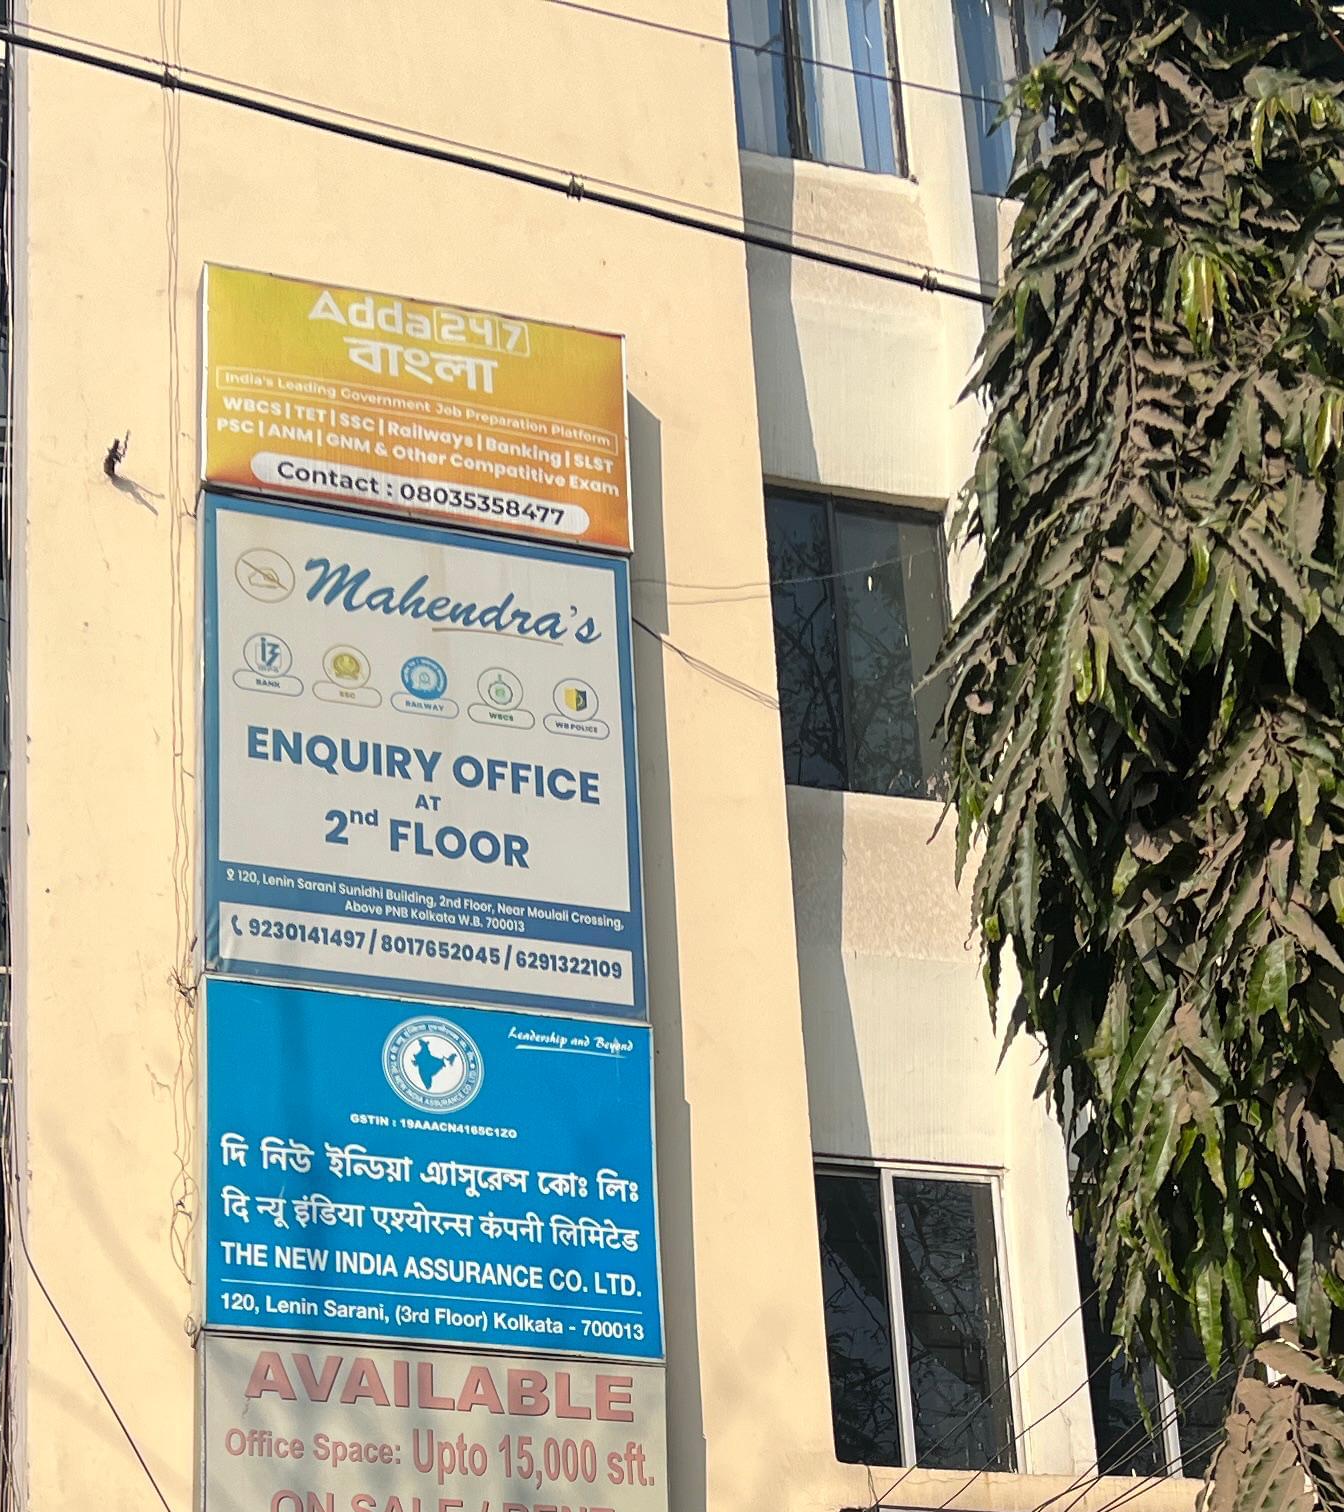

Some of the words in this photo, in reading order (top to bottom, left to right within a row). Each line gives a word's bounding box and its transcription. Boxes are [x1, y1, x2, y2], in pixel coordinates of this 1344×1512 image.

[343, 336, 497, 394] বাংলা
[223, 396, 282, 416] WBCS
[294, 405, 326, 422] TET
[339, 411, 375, 432] SSC
[388, 421, 473, 449] Railways
[486, 437, 561, 468] Banking
[574, 453, 614, 474] SLST
[225, 372, 272, 388] India's
[277, 378, 337, 399] Leading
[341, 386, 431, 413] Government
[437, 402, 462, 417] Job
[466, 407, 548, 434] Preparation
[551, 424, 611, 447] Platform
[217, 418, 253, 435] PSC
[267, 424, 312, 445] ANM
[326, 432, 370, 455] GNM
[391, 445, 447, 470] Other
[569, 474, 619, 497] Exam
[277, 461, 379, 495] Contact
[400, 483, 565, 527] 08035358477
[304, 557, 602, 645] Mahendra's
[247, 726, 442, 784] ENQUIRY
[453, 754, 600, 805] OFFICE
[415, 794, 441, 811] AT
[324, 807, 378, 845] 2nd
[389, 817, 530, 869] FLOOR
[238, 870, 260, 887] 120,
[262, 873, 294, 889] Lenin
[297, 877, 336, 896] Sarani
[339, 881, 383, 901] Sunidhi
[386, 887, 435, 909] Building,
[439, 895, 461, 909] 2nd
[463, 897, 494, 913] Floor,
[497, 902, 524, 917] Near
[527, 906, 569, 923] Moulali
[572, 910, 624, 933] Crossing,
[345, 900, 382, 915] Above
[385, 904, 407, 918] PNB
[410, 906, 455, 924] Kolkata
[457, 913, 483, 927] W.B.
[486, 915, 525, 933] 700013
[249, 918, 365, 950] 9230141497
[380, 934, 500, 965] 8017652045
[515, 949, 622, 979] 6291322109
[508, 1025, 566, 1048] Leadership
[570, 1035, 590, 1048] and
[595, 1037, 634, 1054] Beyond
[350, 1113, 388, 1127] GSTIN
[221, 1133, 248, 1167] দি
[259, 1136, 314, 1173] নিউ
[221, 1186, 249, 1222] दि
[256, 1196, 289, 1230] न्यू
[294, 1193, 365, 1229] इंडिया
[480, 1209, 543, 1245] कंपनी
[551, 1214, 638, 1252] लिमिटेड
[221, 1242, 267, 1267] THE
[275, 1246, 328, 1271] NEW
[335, 1251, 398, 1277] INDIA
[404, 1257, 543, 1290] ASSURANCE
[549, 1267, 589, 1292] CO.
[594, 1270, 642, 1297] LTD.
[221, 1292, 259, 1316] 120,
[266, 1295, 318, 1316] Lenin
[324, 1300, 390, 1324] Sarani,
[395, 1305, 429, 1326] (3rd
[434, 1308, 488, 1332] Floor)
[493, 1311, 564, 1335] Kolkata
[581, 1319, 645, 1341] 700013
[245, 1351, 635, 1423] AVAILABLE
[225, 1428, 304, 1459] Office
[313, 1433, 401, 1468] Space:
[412, 1429, 488, 1485] Upto
[498, 1434, 597, 1490] 15,000
[607, 1441, 655, 1487] sft.
